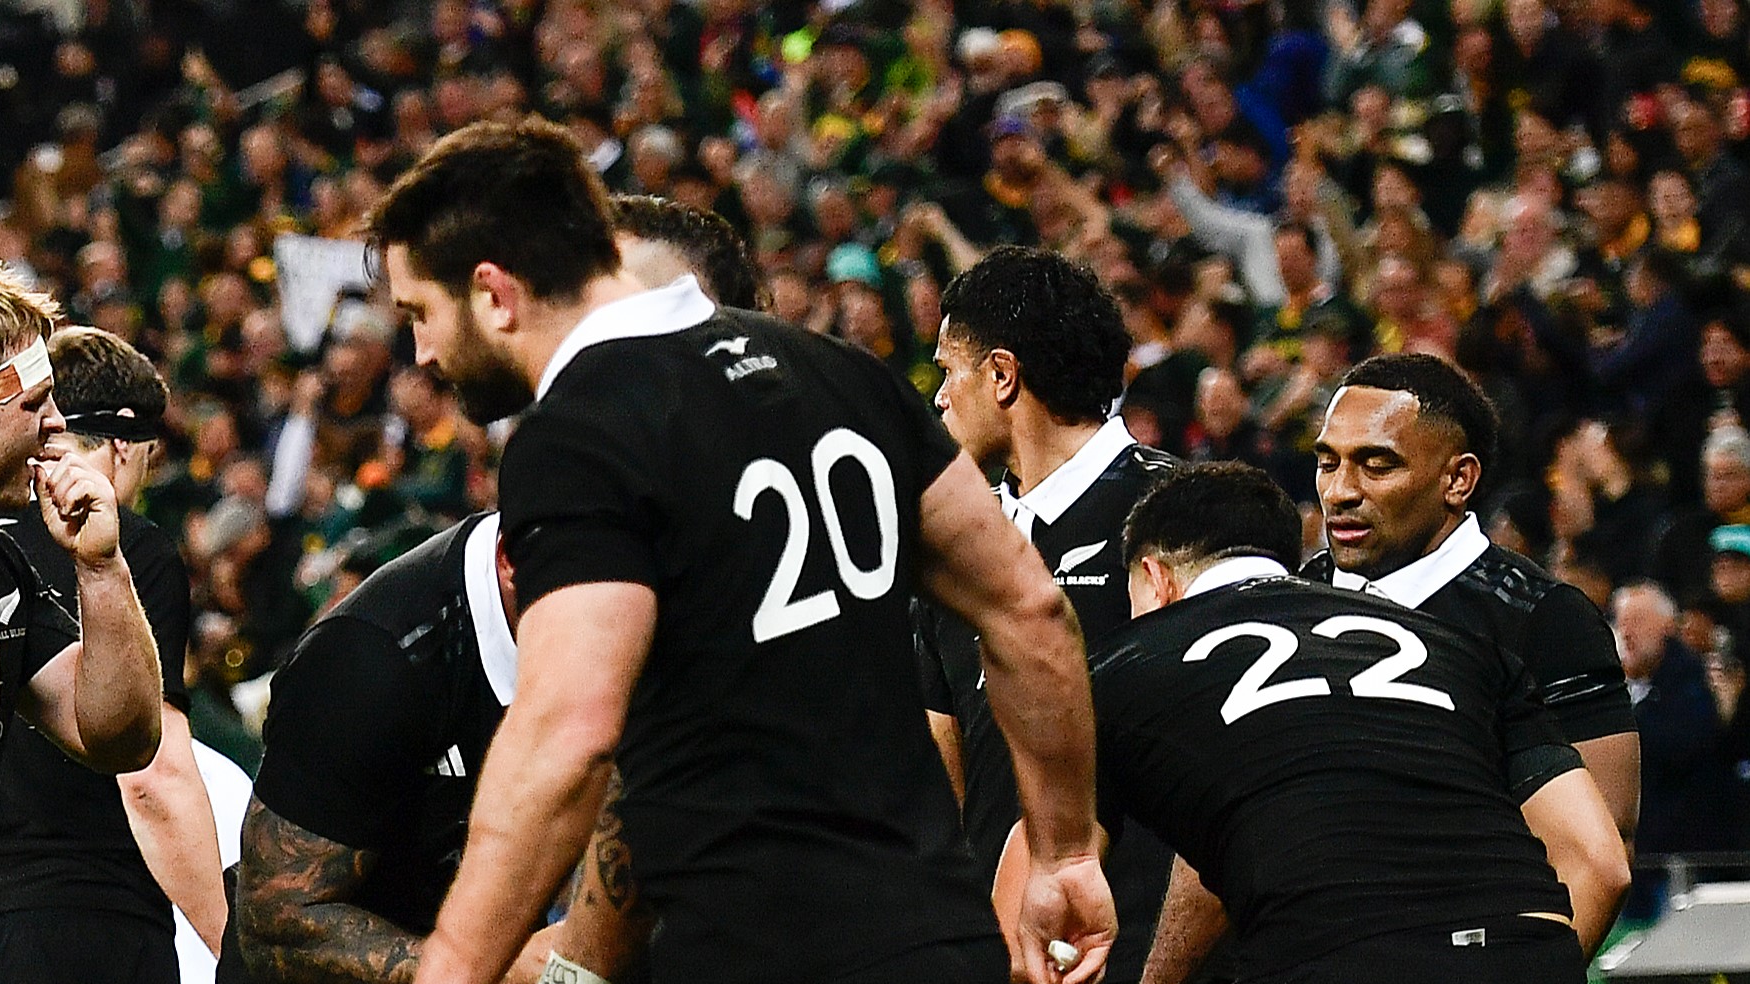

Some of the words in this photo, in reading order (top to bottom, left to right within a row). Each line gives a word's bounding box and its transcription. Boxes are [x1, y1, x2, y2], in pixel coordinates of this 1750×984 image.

[733, 426, 899, 643] 20
[1066, 575, 1106, 586] BLACKS
[1182, 615, 1456, 726] 22
